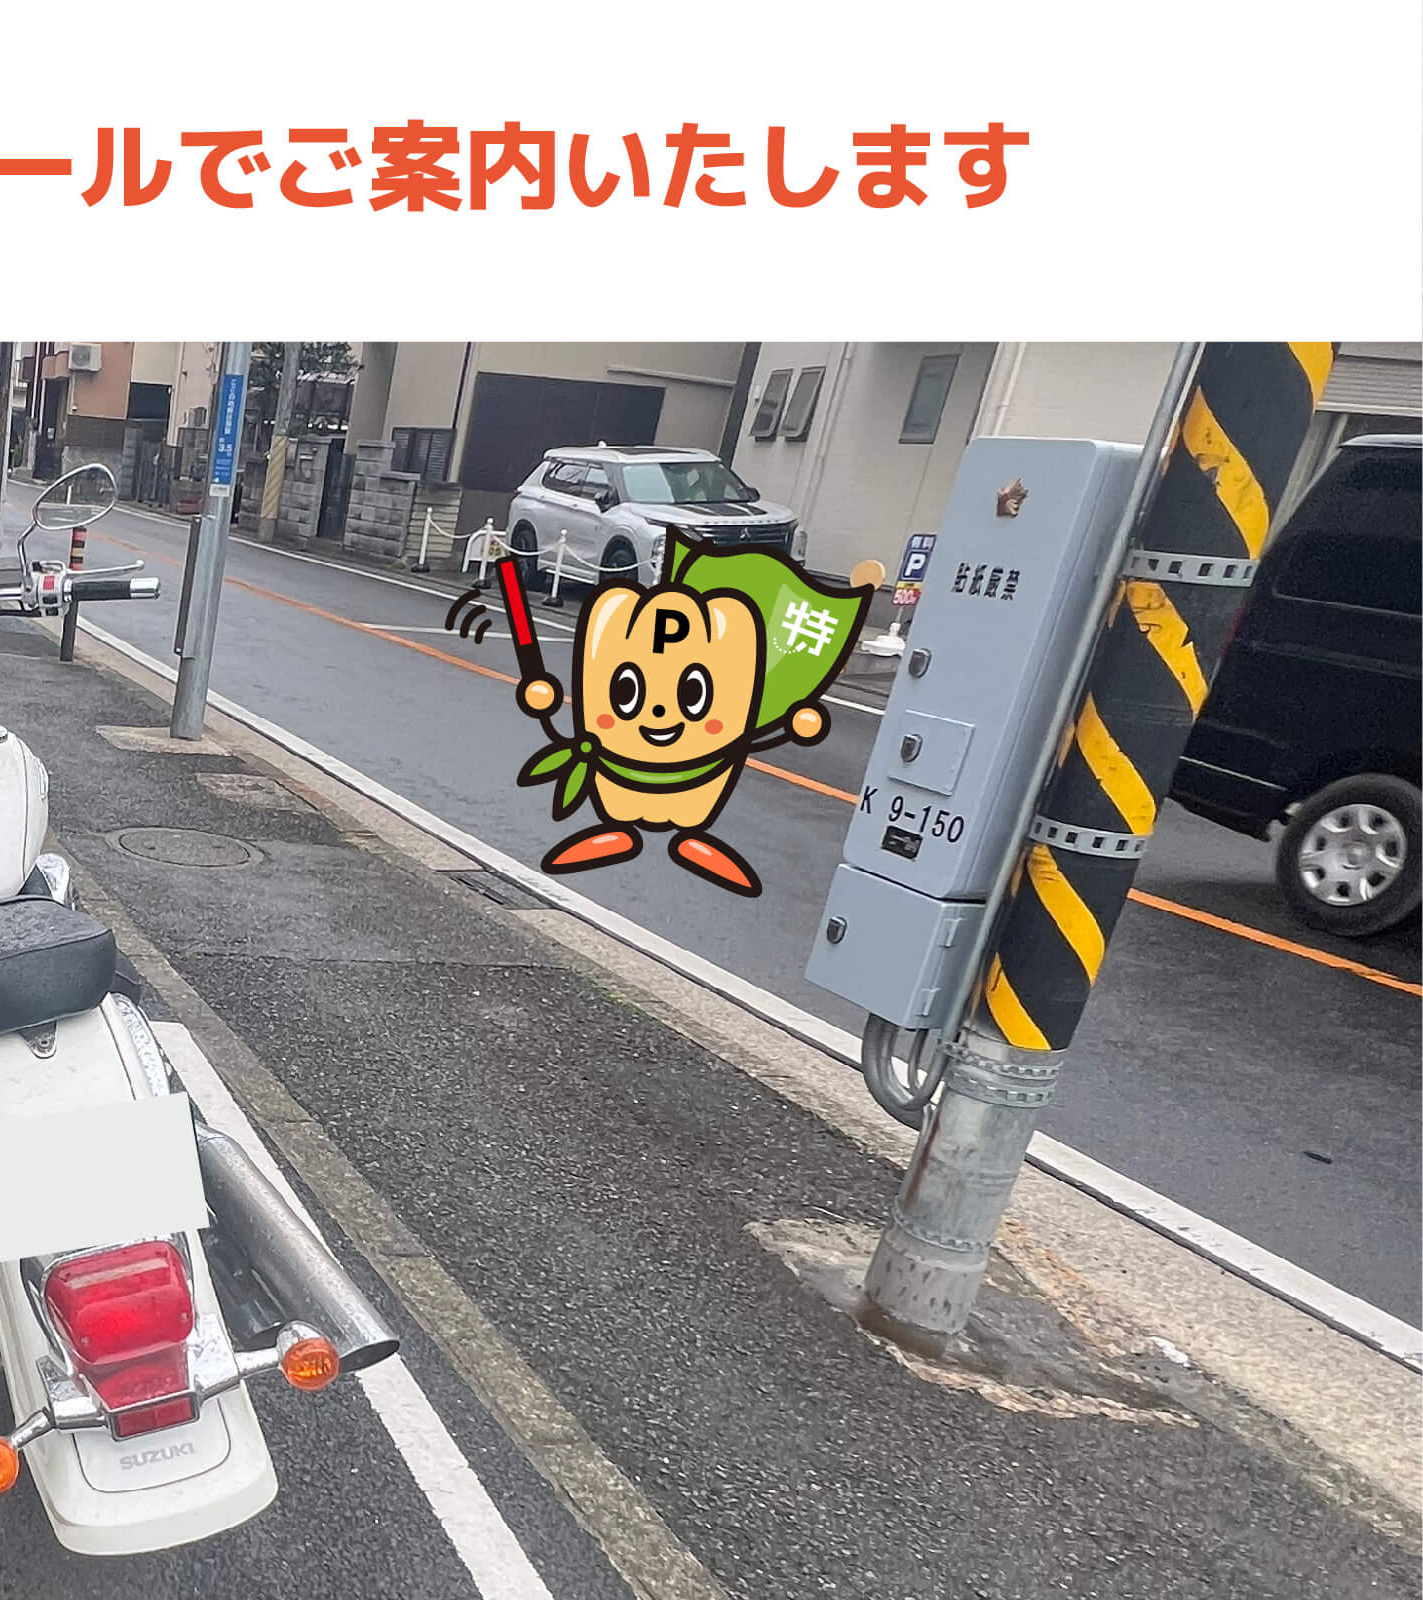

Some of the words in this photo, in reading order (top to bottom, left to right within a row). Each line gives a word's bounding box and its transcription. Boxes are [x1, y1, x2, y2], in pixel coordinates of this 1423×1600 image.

[904, 552, 927, 577] P
[860, 785, 879, 815] K
[888, 795, 965, 843] 9-150
[119, 1442, 195, 1470] SUZUKI
